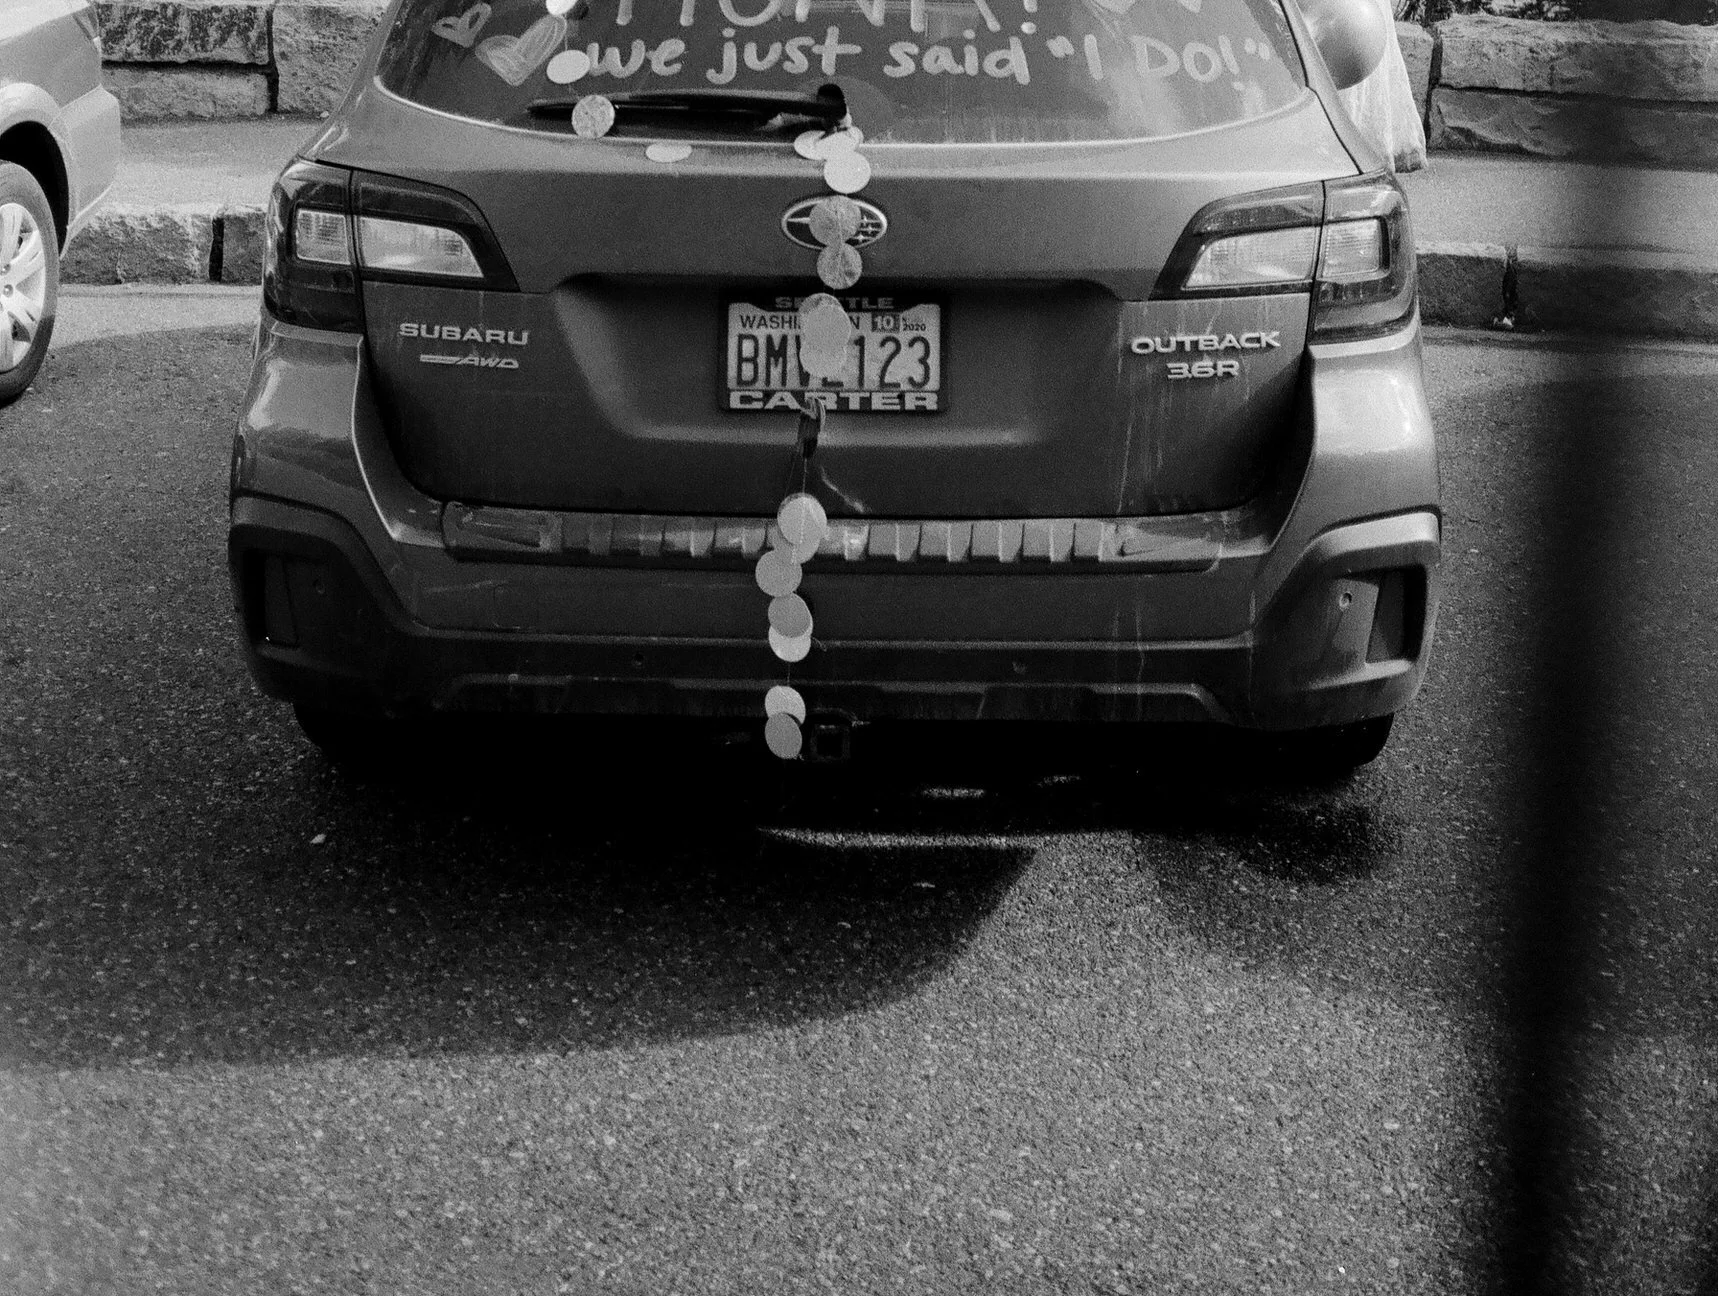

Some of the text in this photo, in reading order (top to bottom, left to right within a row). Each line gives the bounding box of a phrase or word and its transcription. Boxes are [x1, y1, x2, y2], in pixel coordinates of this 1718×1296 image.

[587, 37, 686, 79] we
[706, 24, 862, 85] just
[883, 29, 1032, 85] said
[775, 296, 894, 309] SETLE
[739, 314, 860, 330] WASHIN
[874, 315, 895, 330] 10
[399, 323, 530, 346] SUBARU
[1131, 331, 1281, 354] OUTBACK
[456, 355, 519, 369] AWD
[736, 334, 931, 389] BM123
[1166, 360, 1240, 380] 3.6R
[729, 391, 939, 410] CARTER
